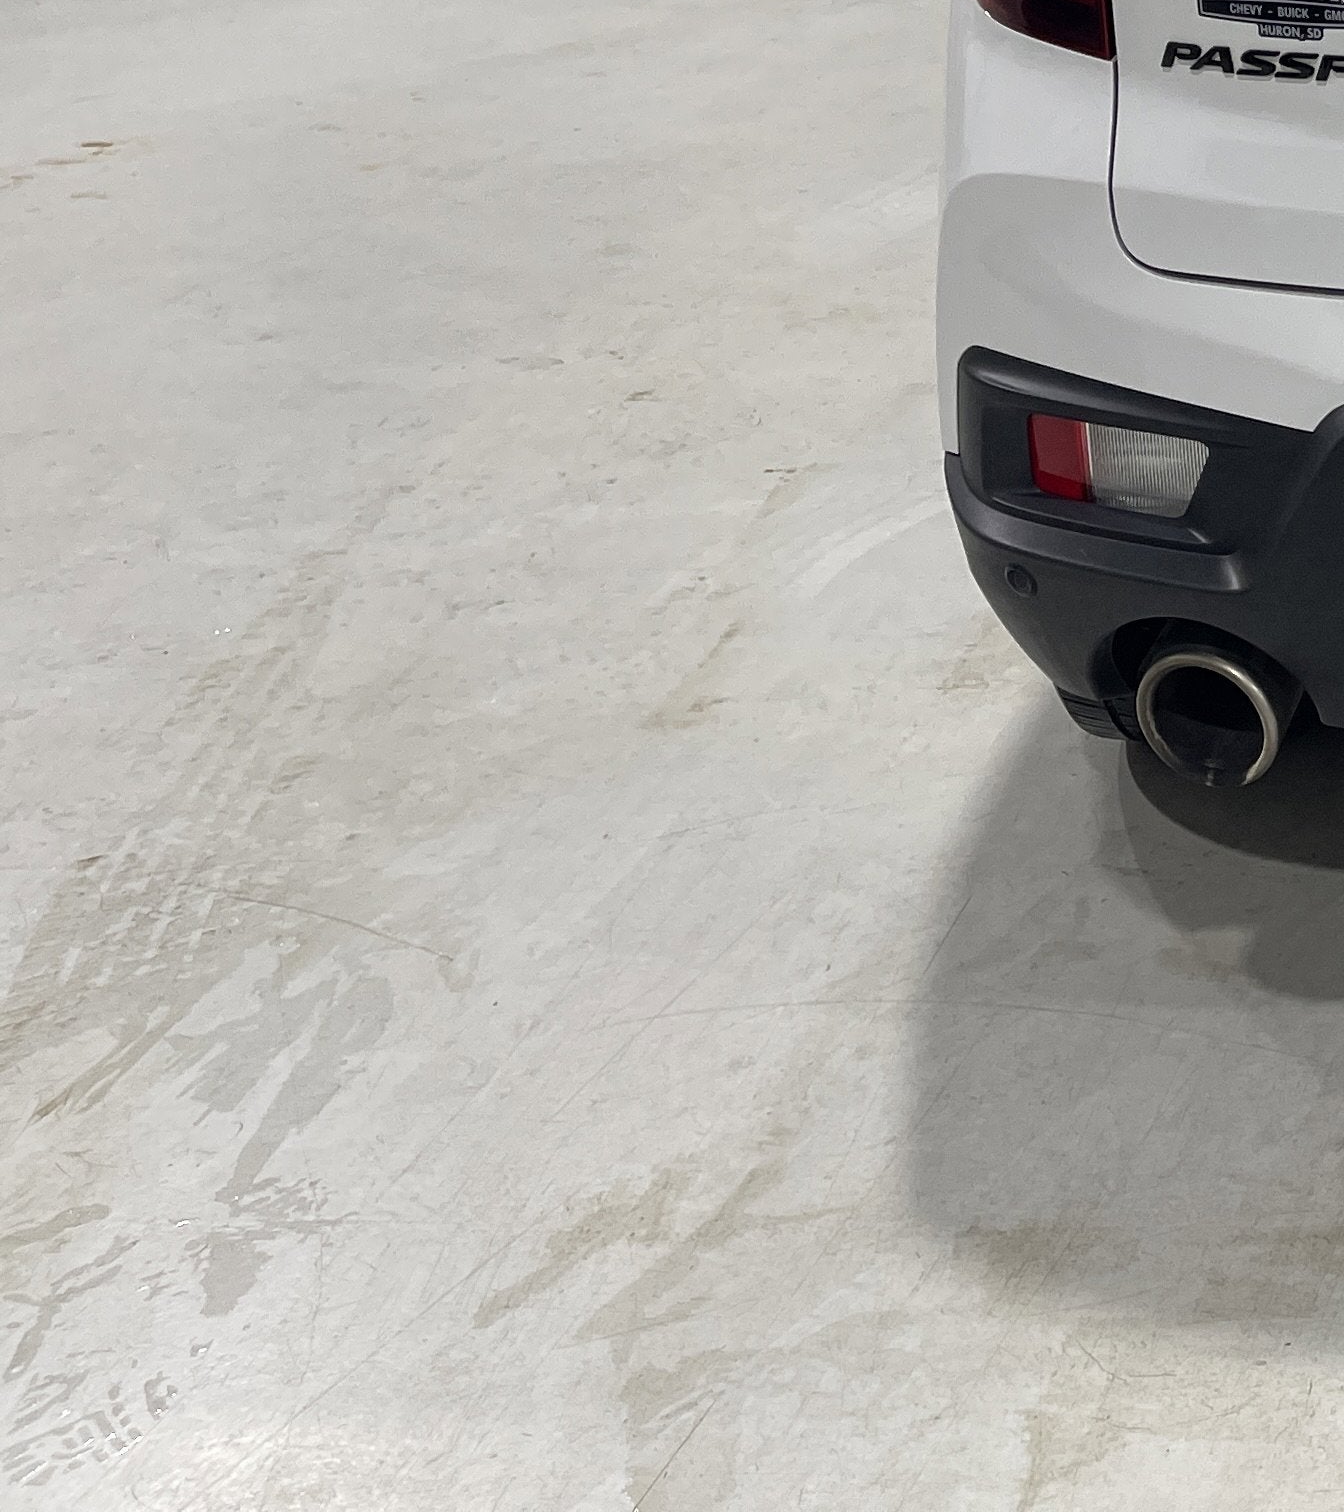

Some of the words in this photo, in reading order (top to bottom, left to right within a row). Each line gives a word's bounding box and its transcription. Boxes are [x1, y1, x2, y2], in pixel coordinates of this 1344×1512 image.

[1229, 3, 1263, 16] CHEVY
[1277, 6, 1309, 19] BUICK
[1260, 24, 1305, 39] HURON,
[1307, 28, 1322, 39] SD
